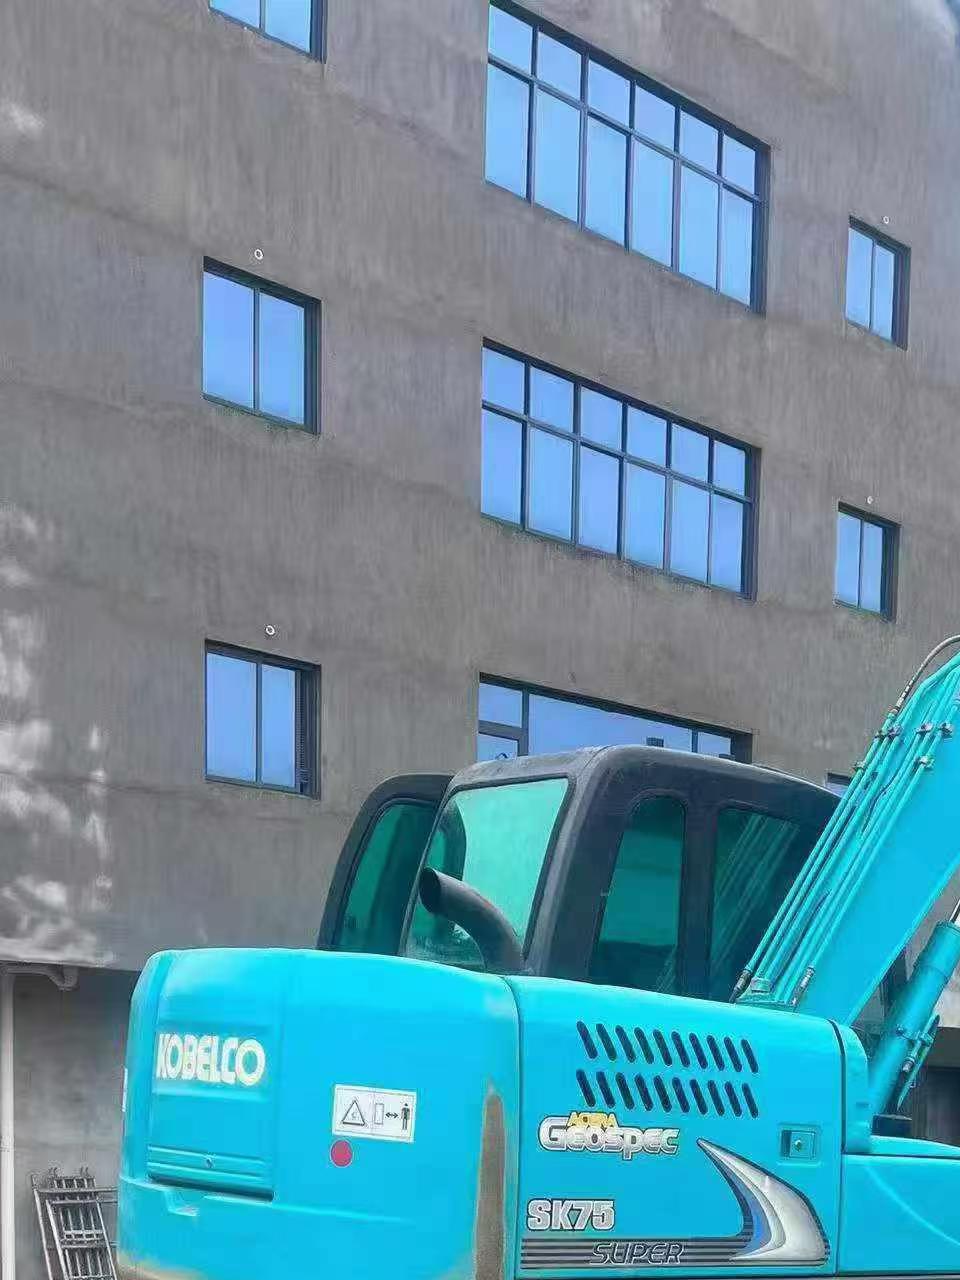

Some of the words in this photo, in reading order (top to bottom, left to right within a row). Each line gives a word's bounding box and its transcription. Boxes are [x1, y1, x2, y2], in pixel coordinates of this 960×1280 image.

[156, 1033, 266, 1086] KOBELCO
[527, 1199, 615, 1231] SK75
[589, 1242, 684, 1265] SUPER
